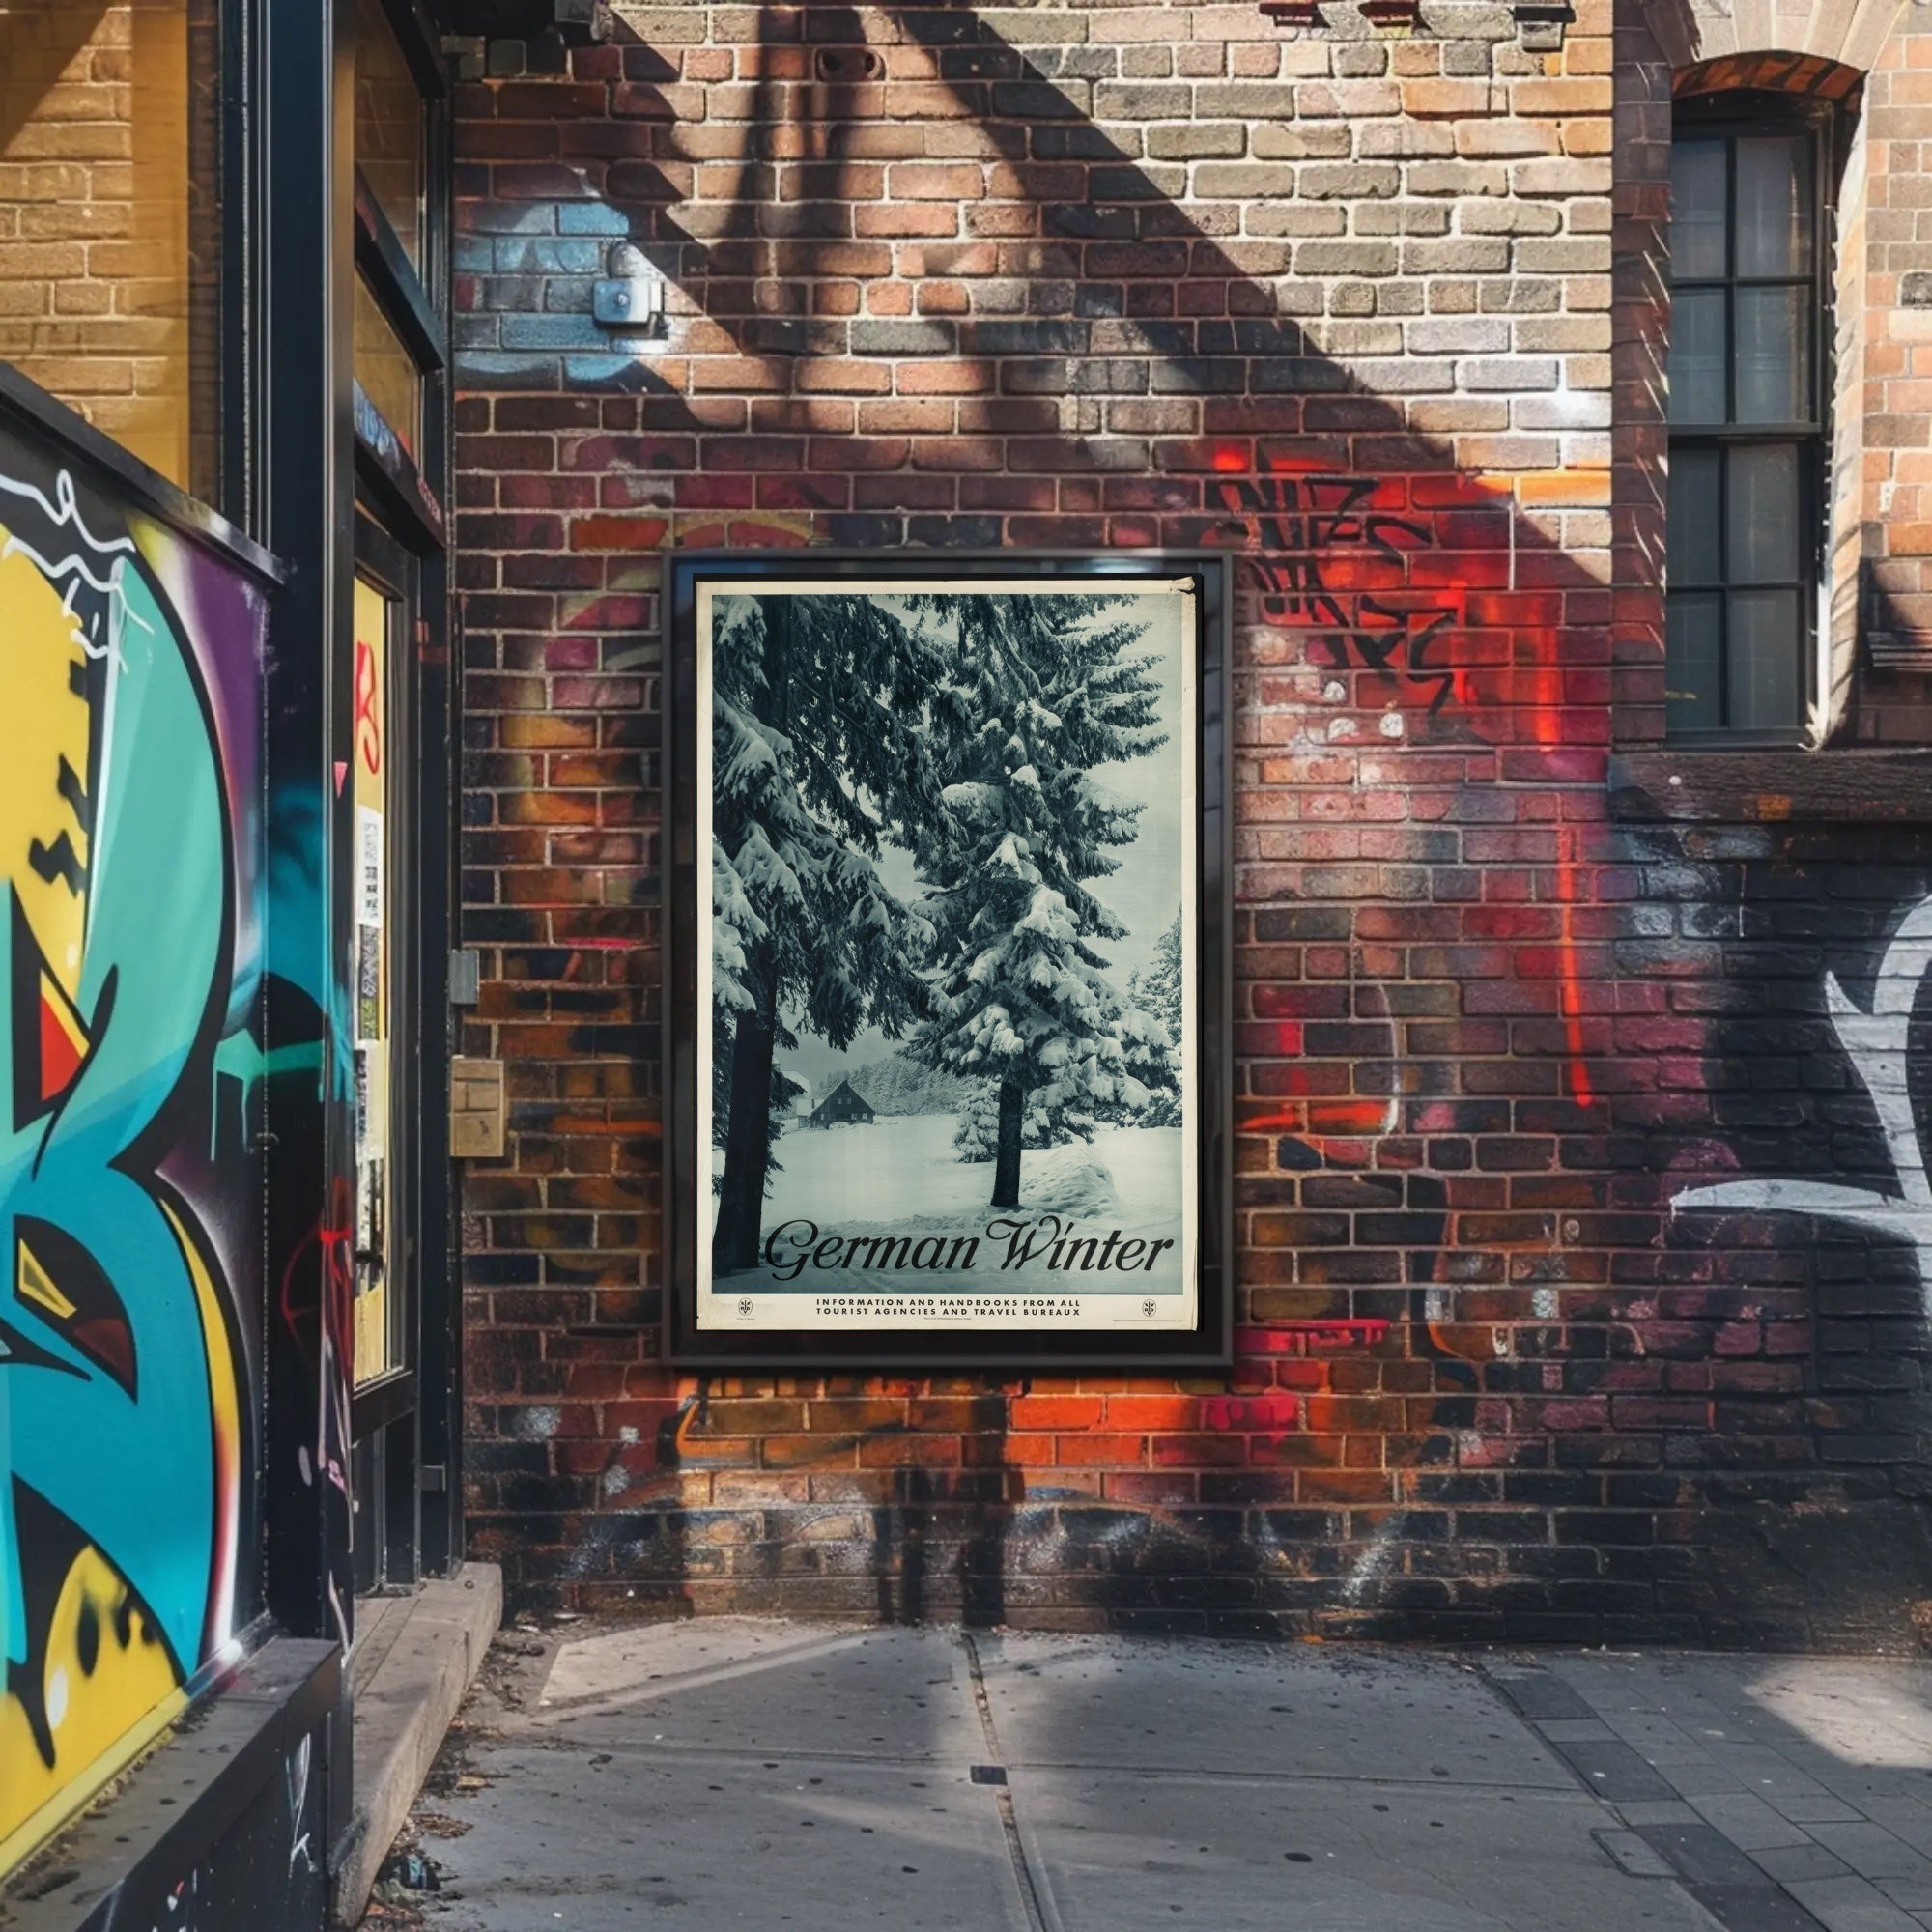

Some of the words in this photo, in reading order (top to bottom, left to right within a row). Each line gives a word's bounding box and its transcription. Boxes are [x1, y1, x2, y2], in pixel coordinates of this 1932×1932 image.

[765, 1219, 979, 1282] German
[985, 1215, 1175, 1272] Winter
[815, 1298, 904, 1307] INFORMATION
[909, 1298, 935, 1307] AND
[939, 1298, 1018, 1307] HANDBOOKS
[1022, 1298, 1055, 1307] FROM
[1060, 1298, 1081, 1307] ALL
